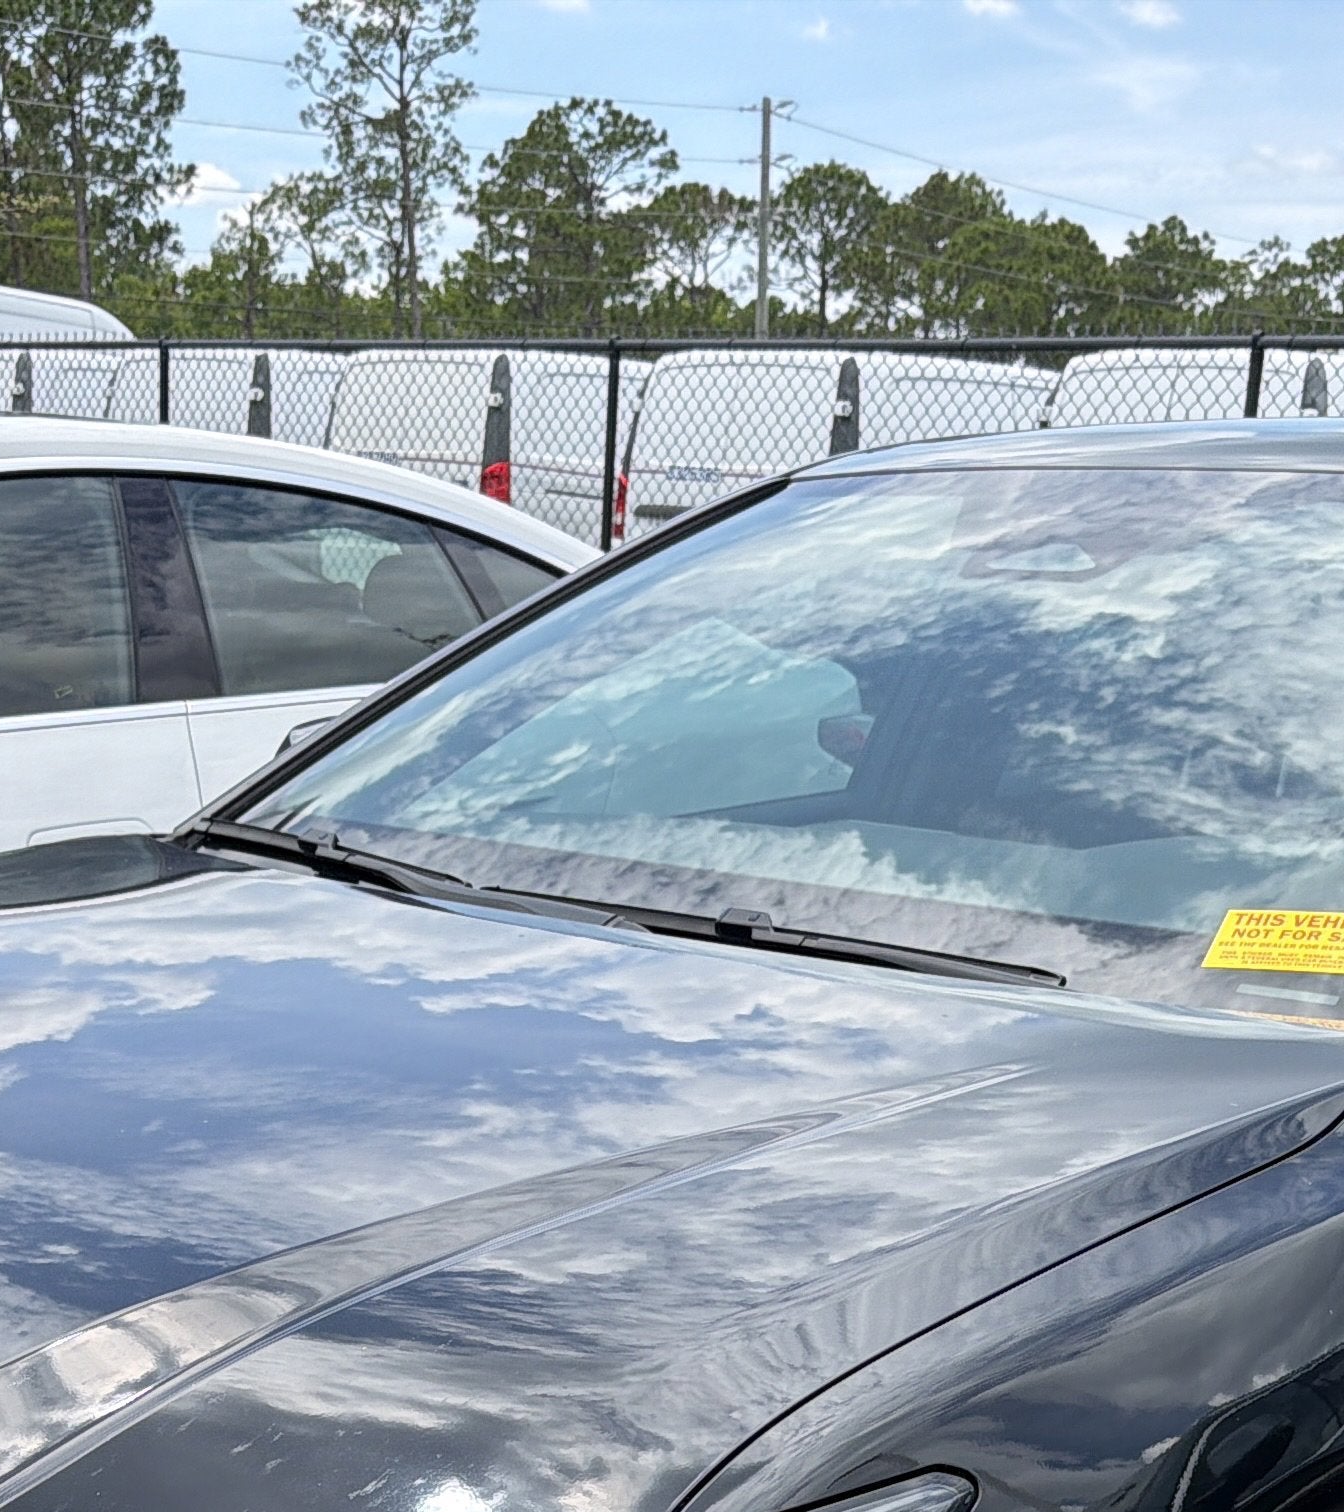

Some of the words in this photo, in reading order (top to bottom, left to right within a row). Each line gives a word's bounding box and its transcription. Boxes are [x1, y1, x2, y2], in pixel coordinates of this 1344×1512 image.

[1234, 913, 1286, 926] THIS
[1230, 928, 1274, 939] NOT
[1278, 929, 1322, 941] FOR
